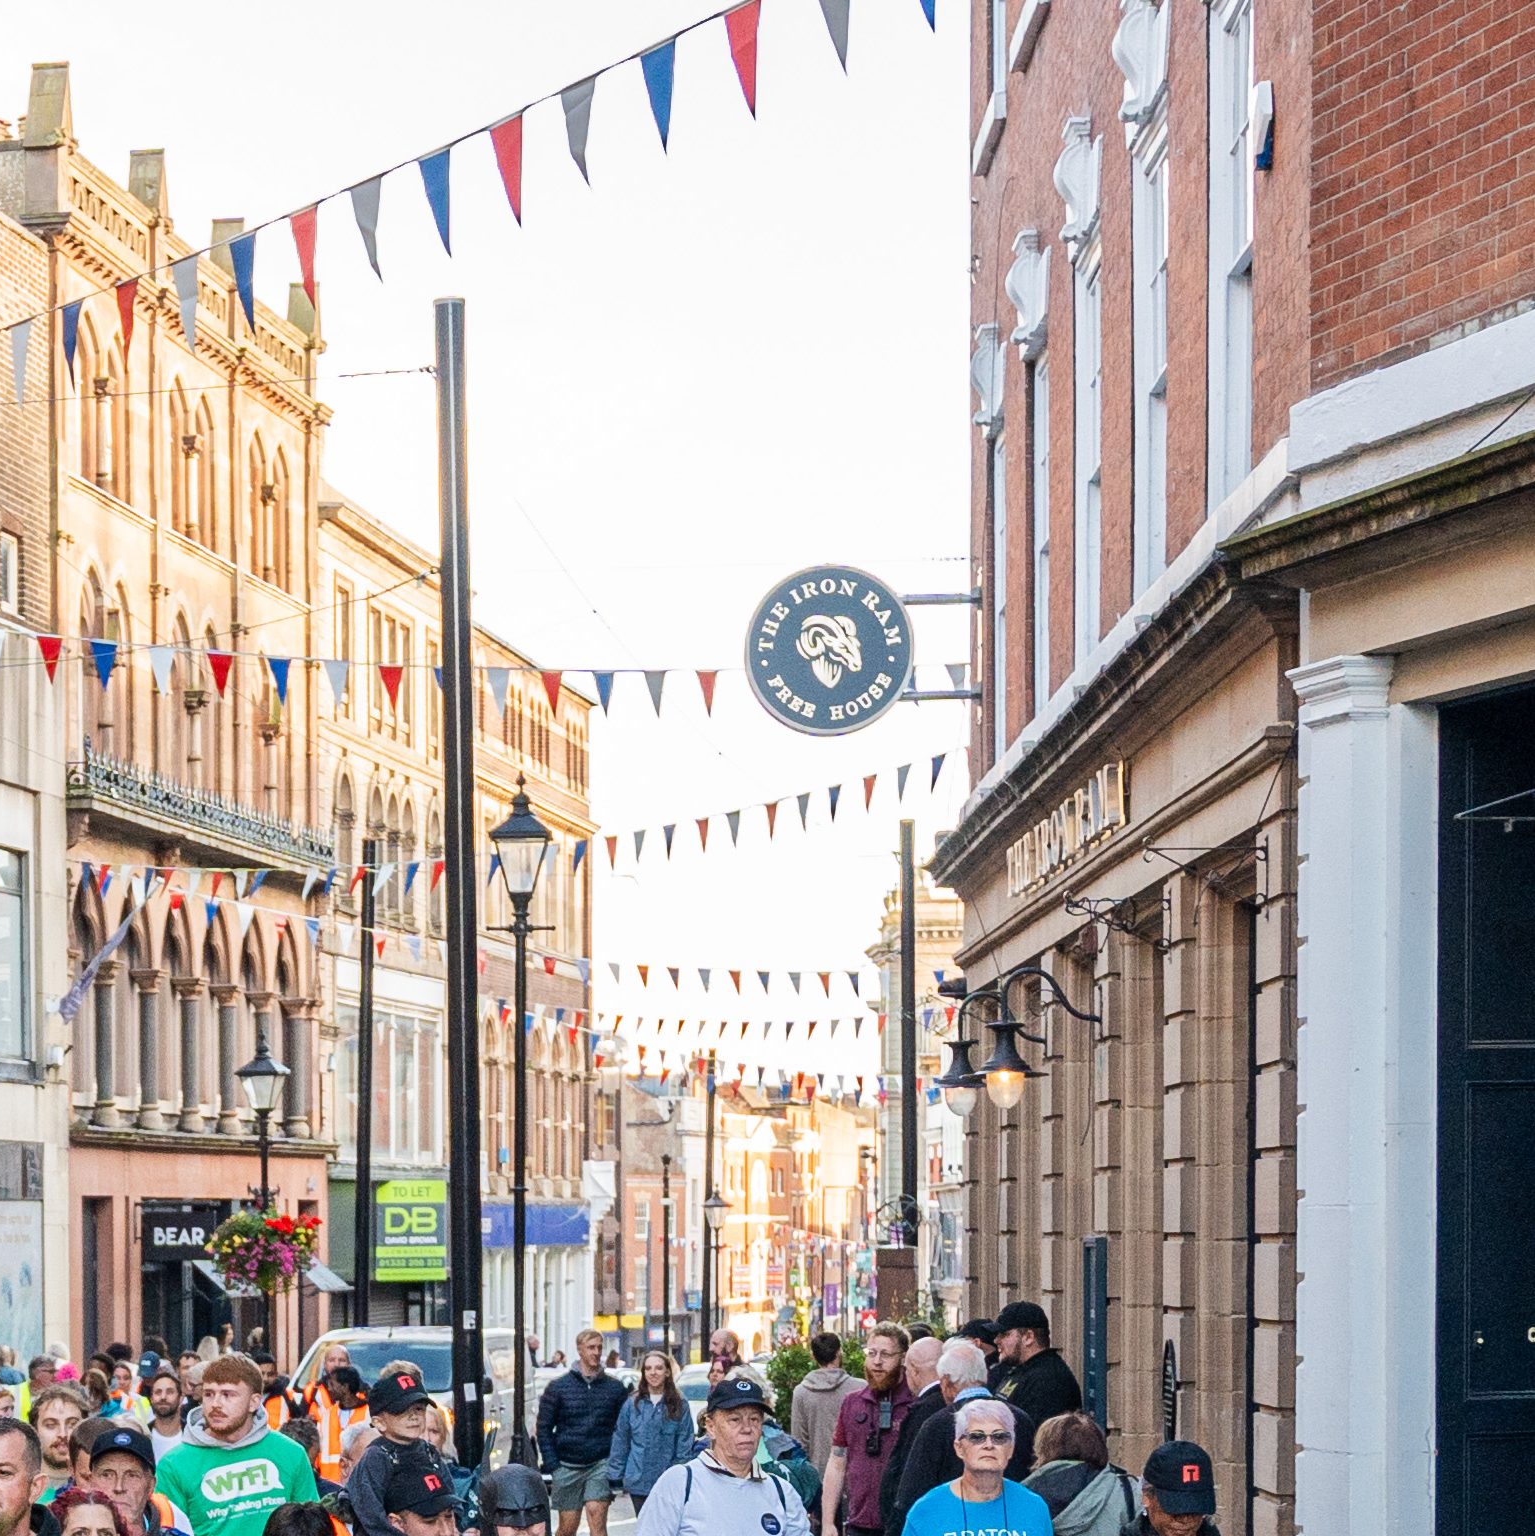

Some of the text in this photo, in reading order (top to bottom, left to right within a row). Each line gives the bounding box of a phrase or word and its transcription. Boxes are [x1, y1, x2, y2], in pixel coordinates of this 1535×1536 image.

[758, 578, 902, 653] THE IRON RAM
[767, 672, 892, 720] FREE HOUSE
[1006, 759, 1126, 898] THE IRON RAM
[392, 1185, 431, 1198] TO LET
[153, 1226, 205, 1246] BEAR
